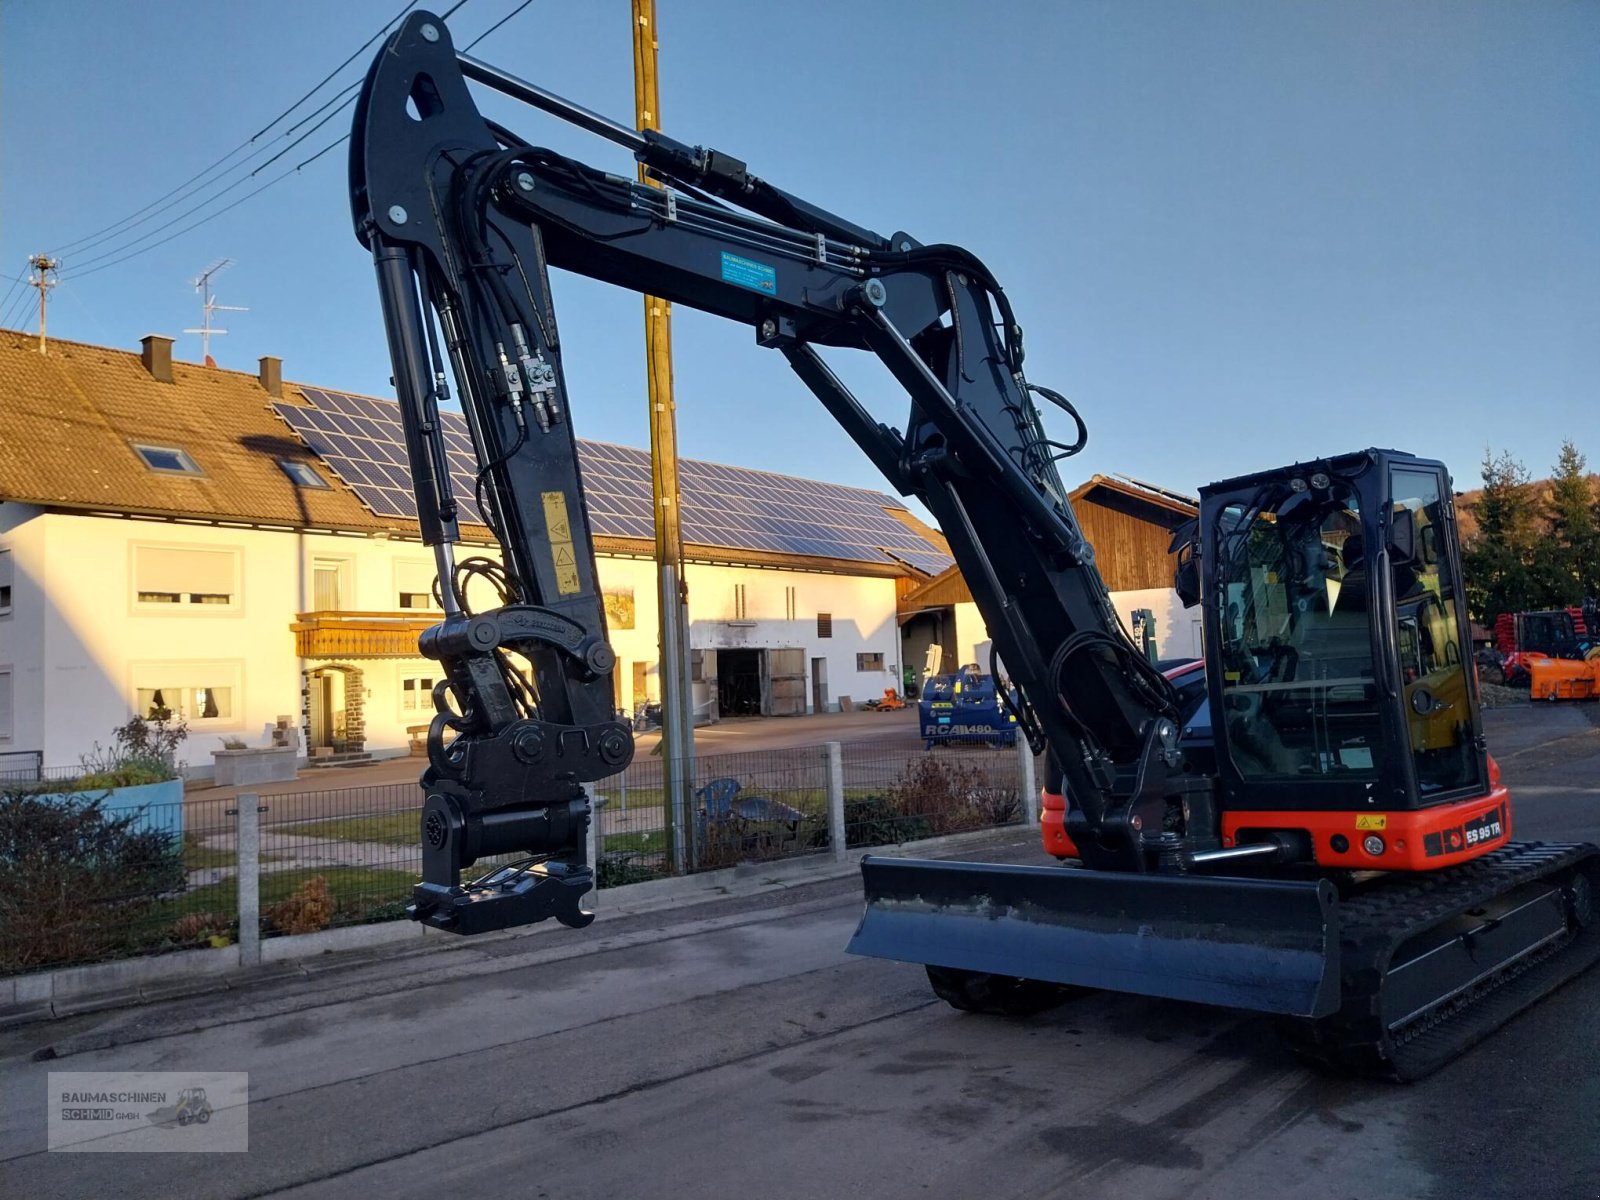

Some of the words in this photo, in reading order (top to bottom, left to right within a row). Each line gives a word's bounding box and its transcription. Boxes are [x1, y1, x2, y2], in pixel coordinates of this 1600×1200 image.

[1466, 829, 1478, 844] ES
[1478, 825, 1490, 840] 95
[1490, 821, 1501, 836] TR
